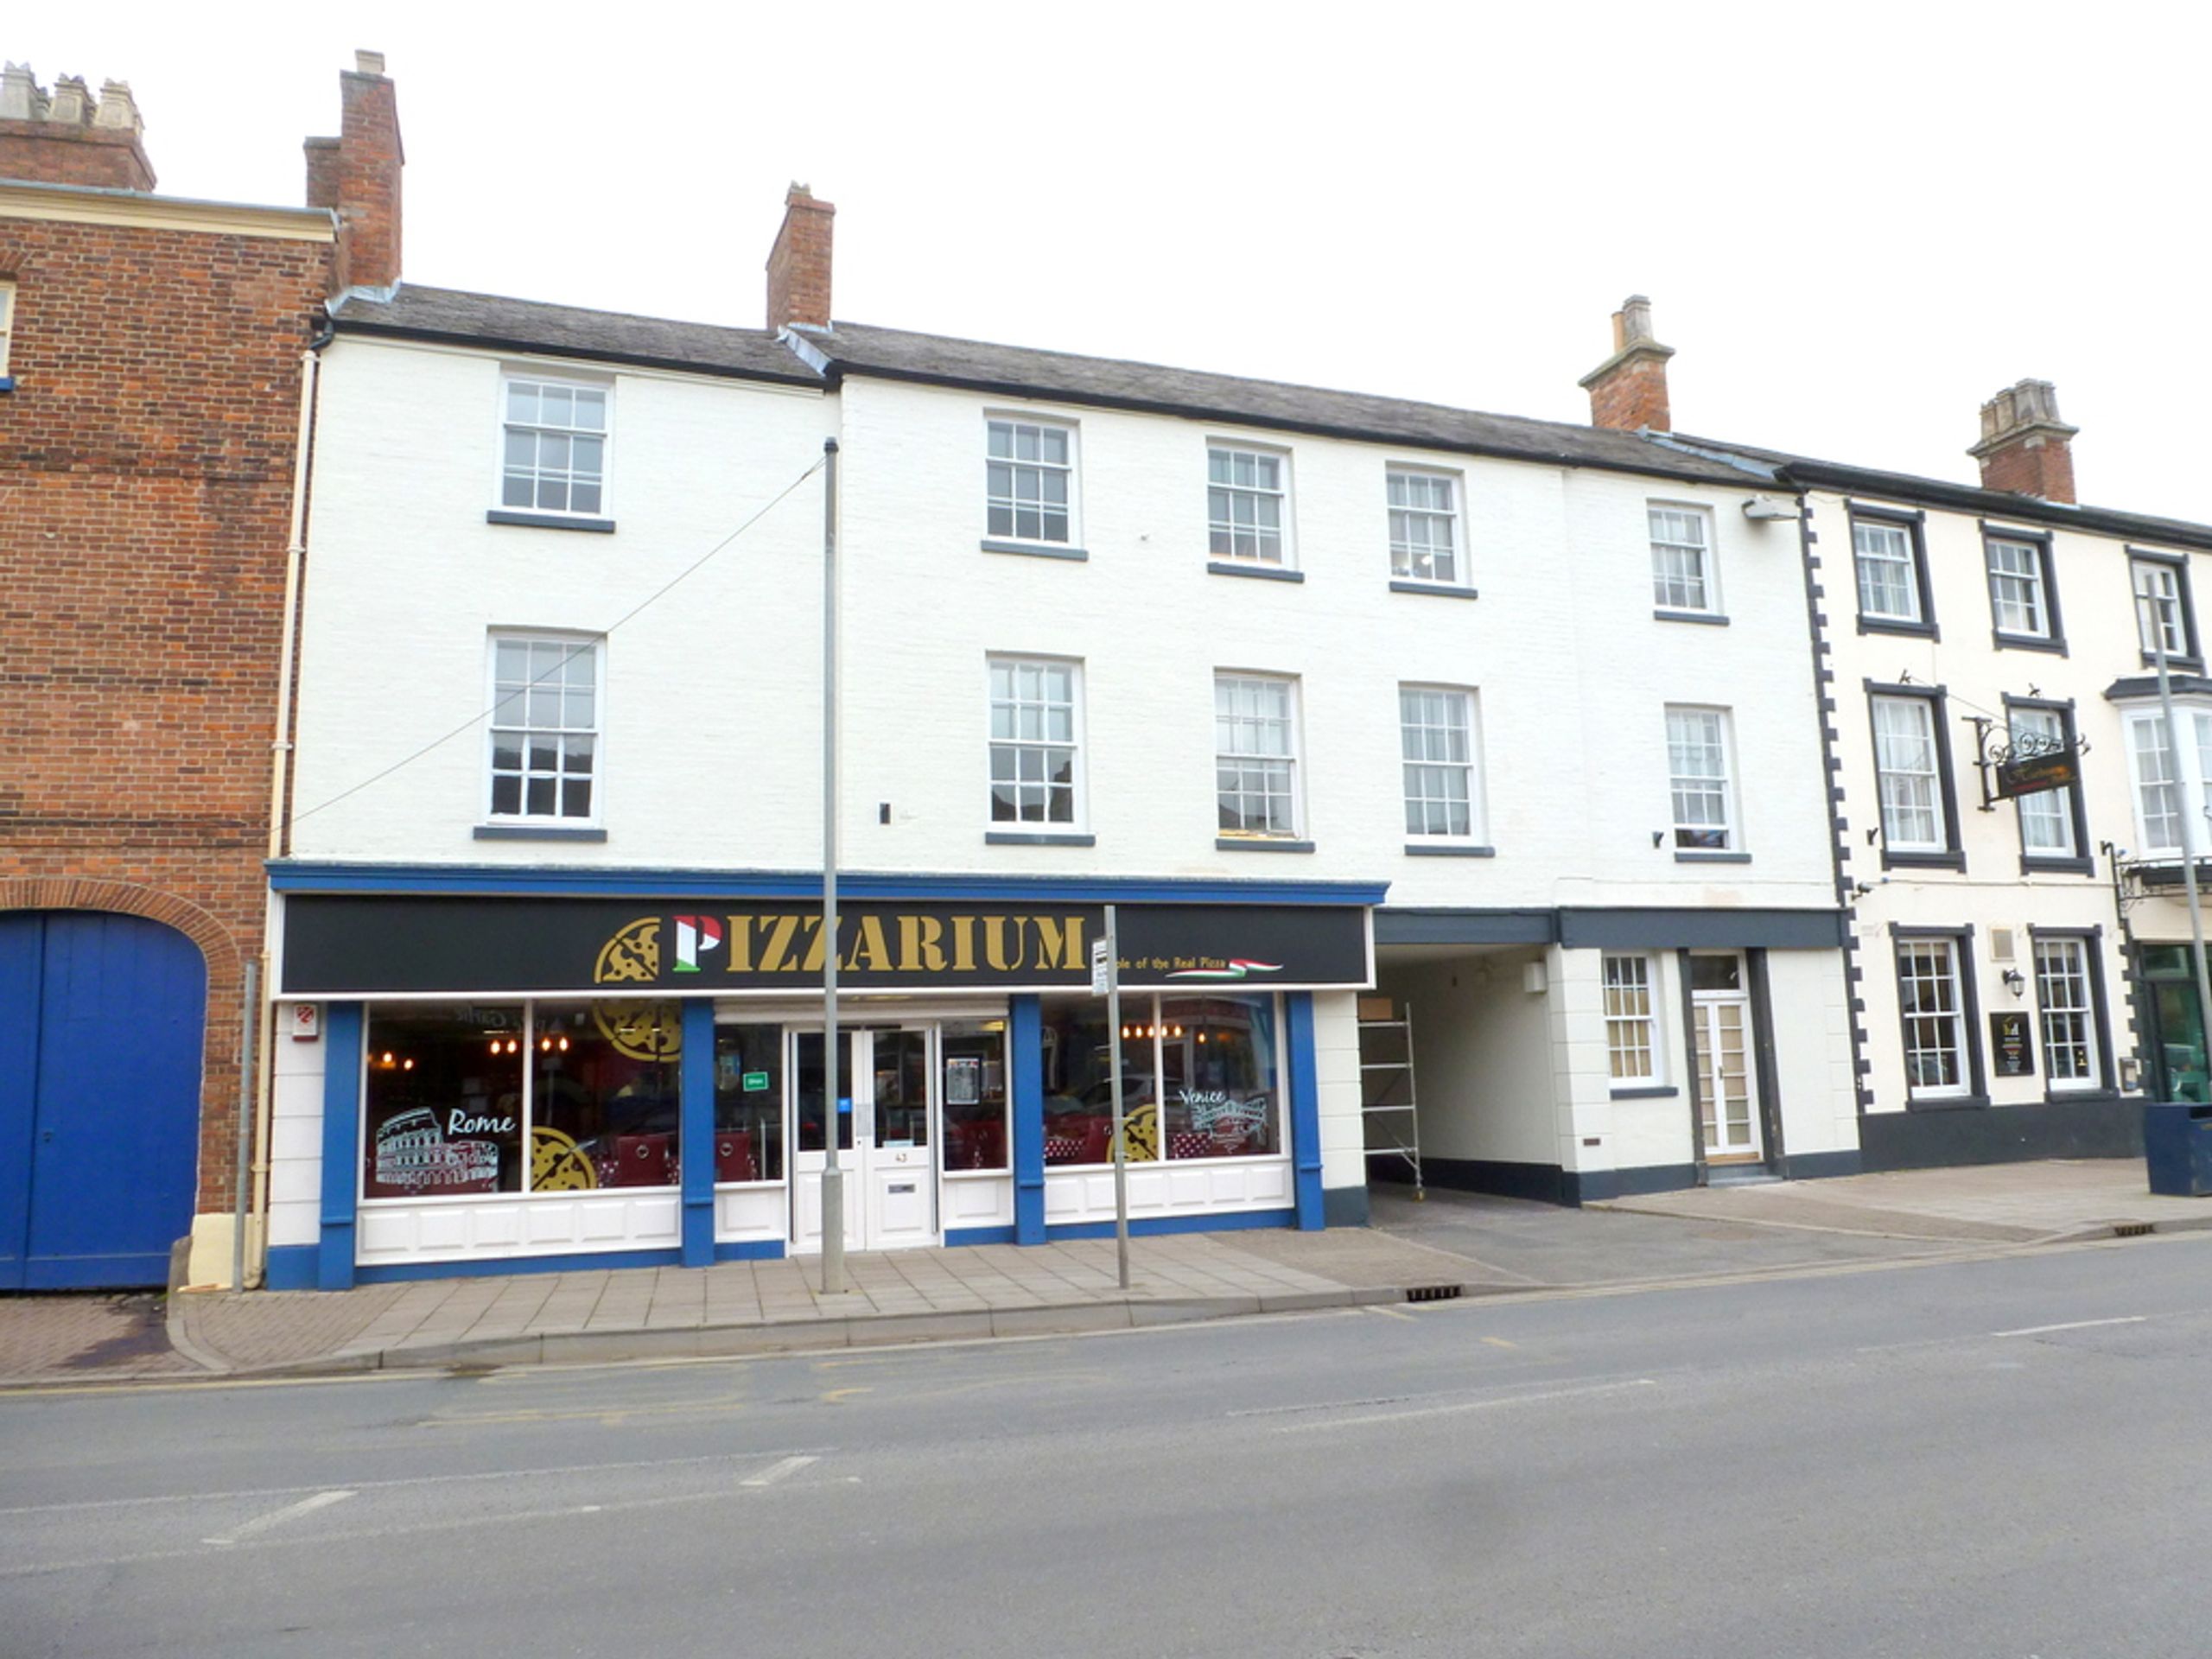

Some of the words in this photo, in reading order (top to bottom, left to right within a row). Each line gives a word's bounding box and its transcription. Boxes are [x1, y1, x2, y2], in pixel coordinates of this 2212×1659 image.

[672, 915, 1085, 973] PIZZARIUM
[1135, 956, 1148, 969] of
[1178, 1087, 1227, 1104] Venice
[448, 1108, 517, 1135] Rome
